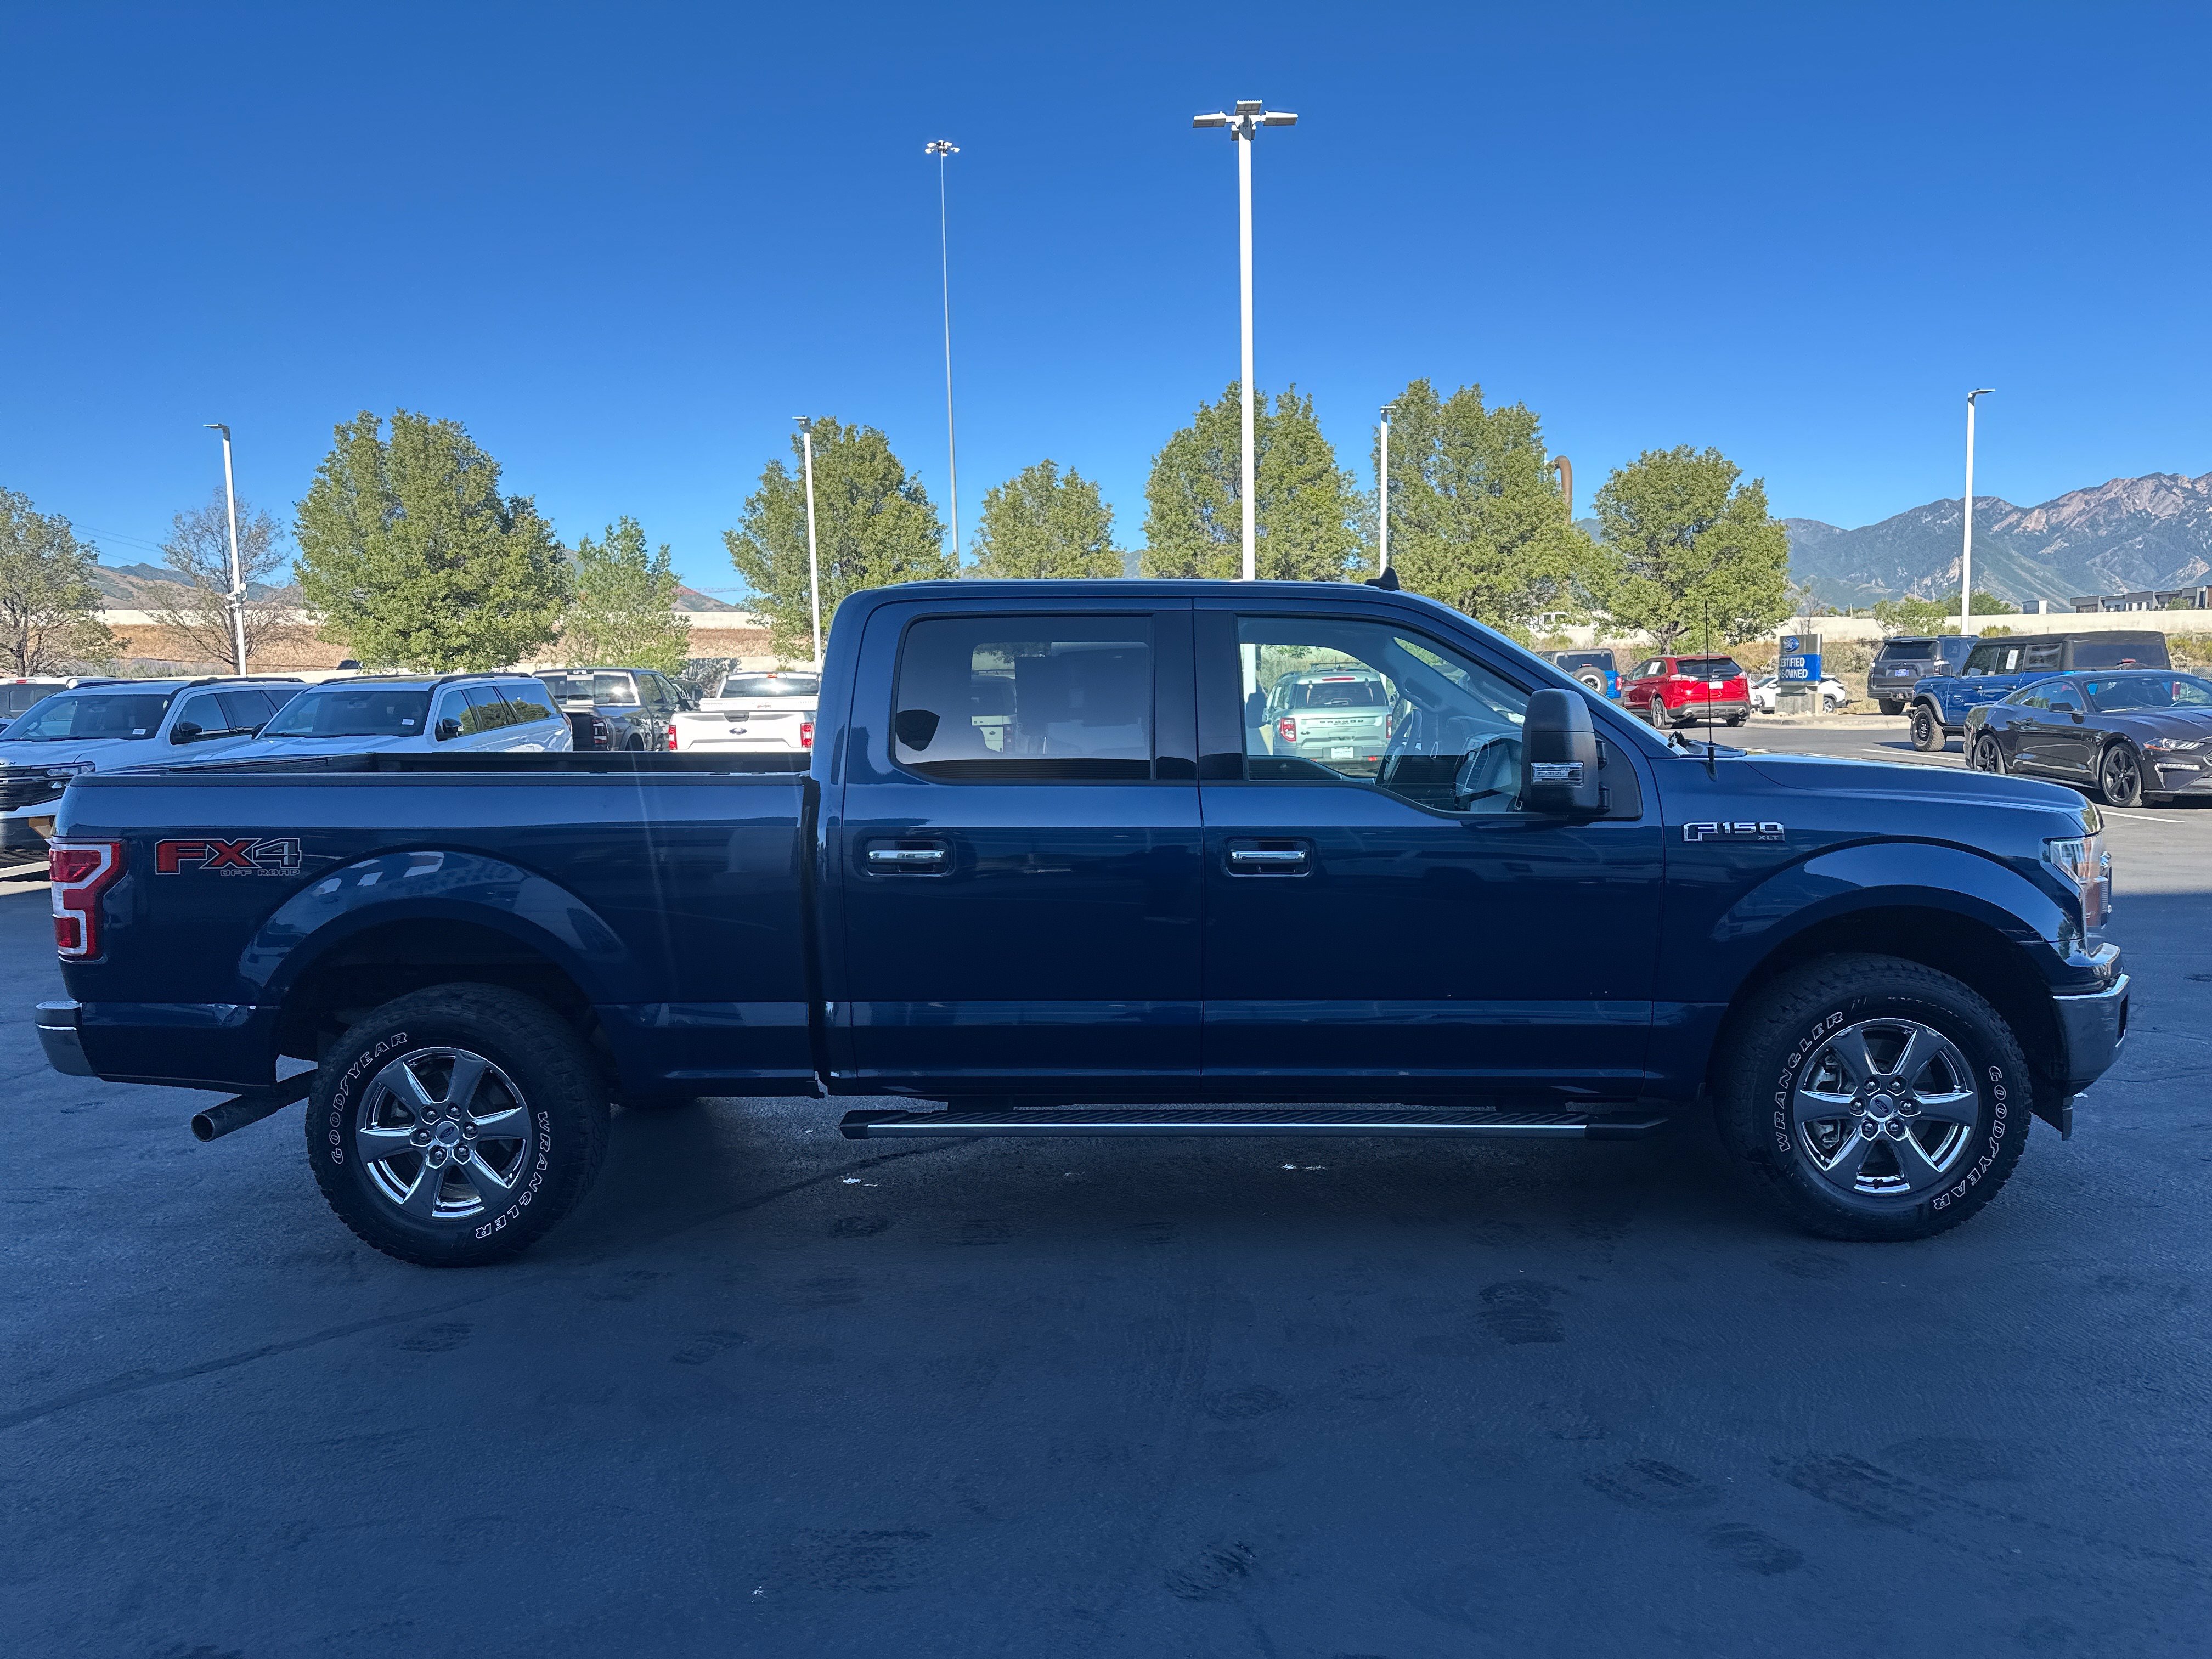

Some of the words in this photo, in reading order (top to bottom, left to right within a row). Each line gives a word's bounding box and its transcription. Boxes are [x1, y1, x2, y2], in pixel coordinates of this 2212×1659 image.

[155, 837, 302, 876] FX4
[220, 868, 252, 877] OFF
[329, 1032, 408, 1165] GOODYEAR
[1773, 1011, 1843, 1152] WRANGLER
[1933, 1065, 2007, 1210] GOODYEAR
[475, 1111, 551, 1239] WRANGLER
